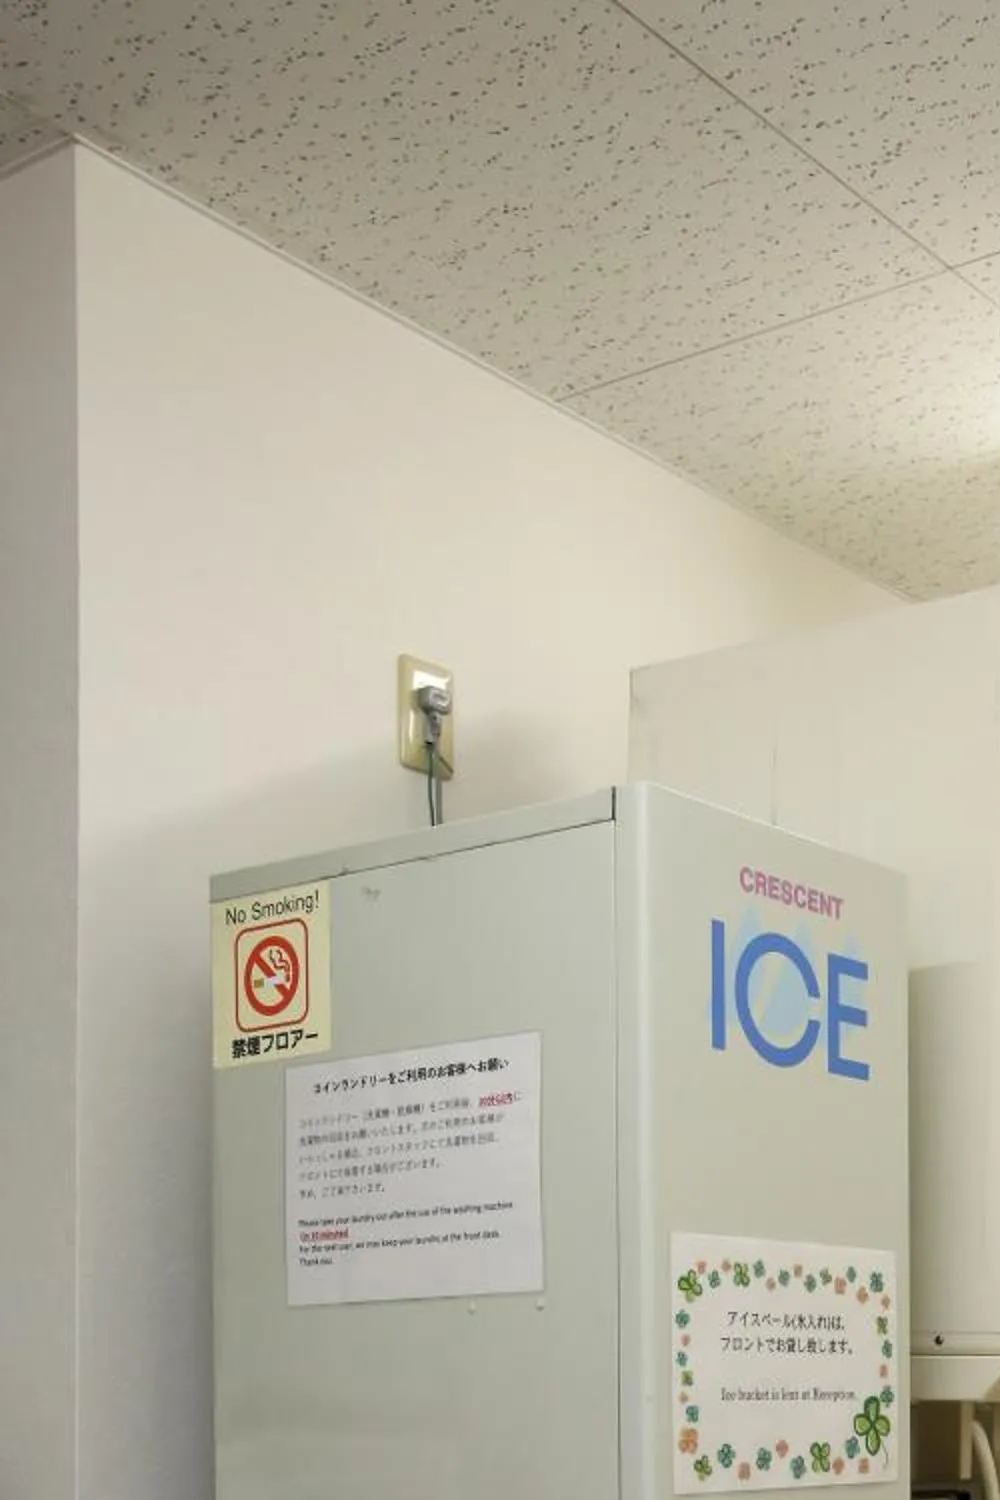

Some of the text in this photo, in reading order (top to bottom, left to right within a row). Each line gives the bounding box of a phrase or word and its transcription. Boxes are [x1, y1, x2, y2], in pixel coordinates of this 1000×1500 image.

[225, 890, 319, 925] No Smoking!
[739, 866, 843, 920] CRESCENT
[711, 919, 870, 1081] ICE
[232, 1028, 319, 1059] 禁煙フロアー
